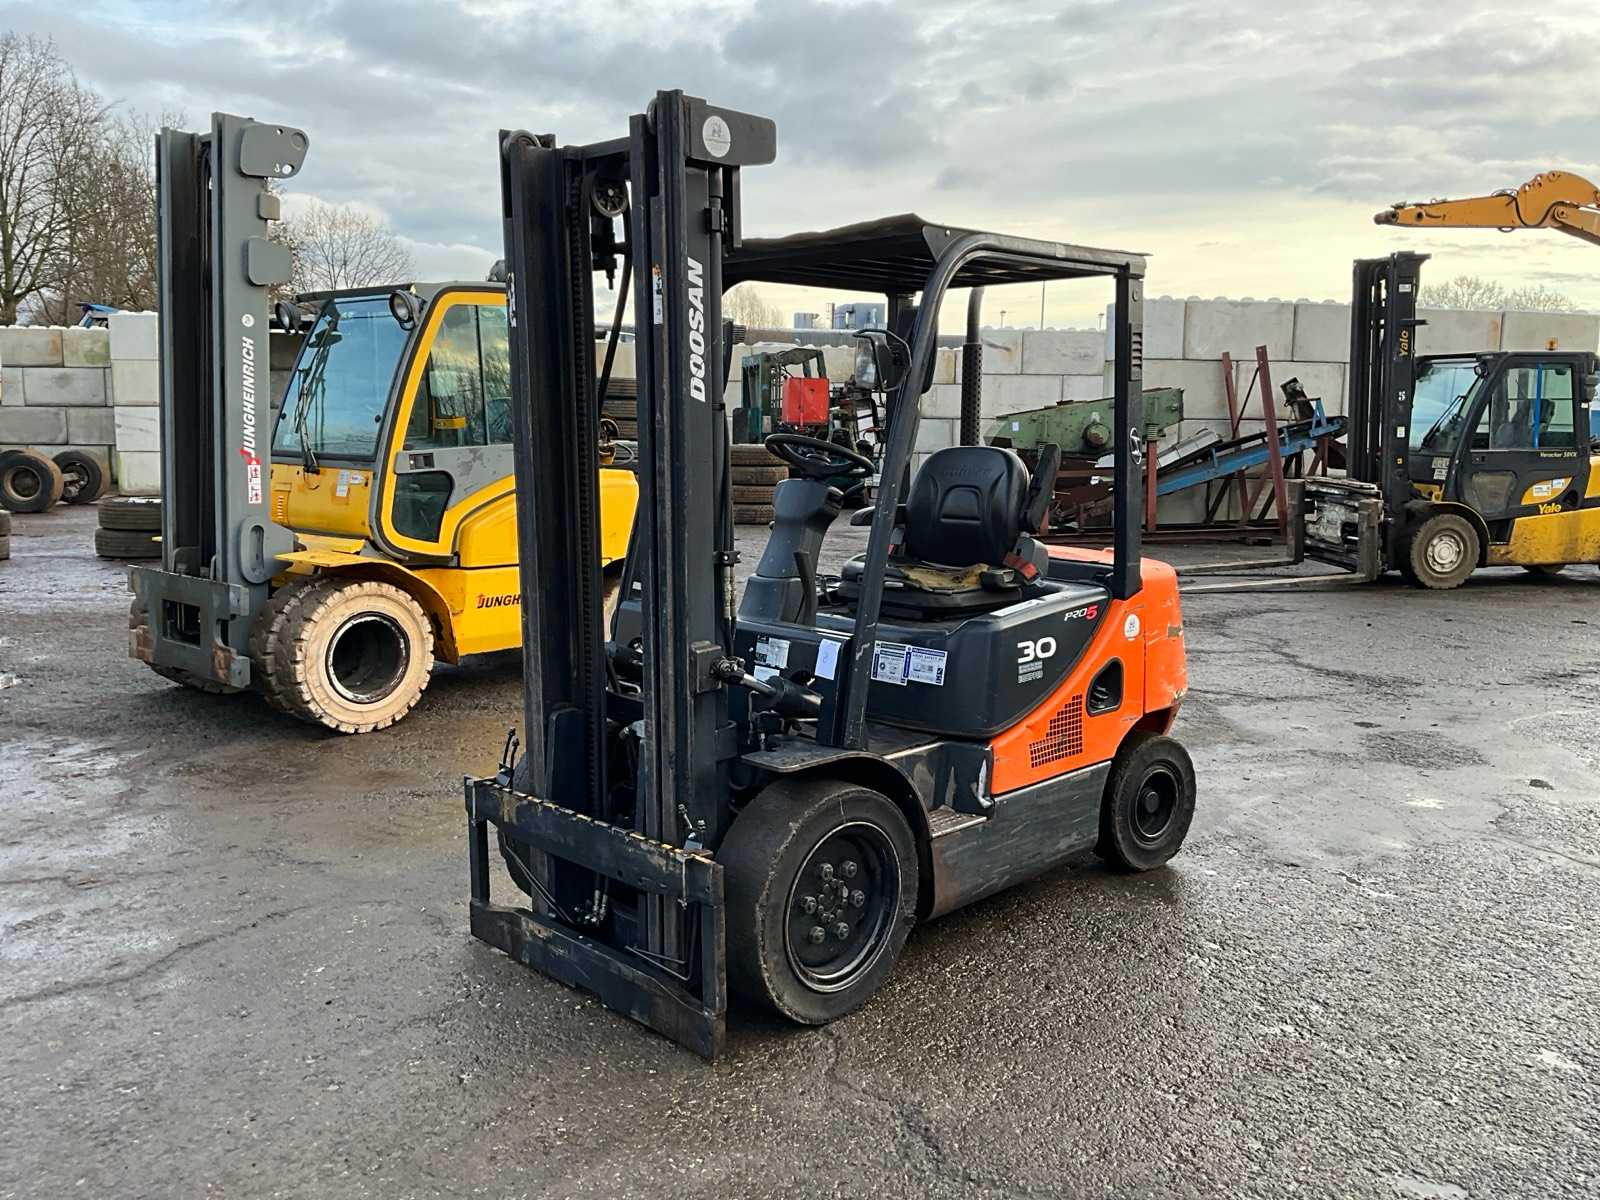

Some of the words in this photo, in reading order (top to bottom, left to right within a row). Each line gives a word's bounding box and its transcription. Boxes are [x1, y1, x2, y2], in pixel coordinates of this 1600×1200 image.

[687, 257, 706, 402] DOOSAN
[241, 337, 255, 458] JUNGHEINRICH
[1538, 502, 1562, 515] Yale
[1064, 605, 1099, 622] PRO5
[1017, 636, 1057, 664] 30
